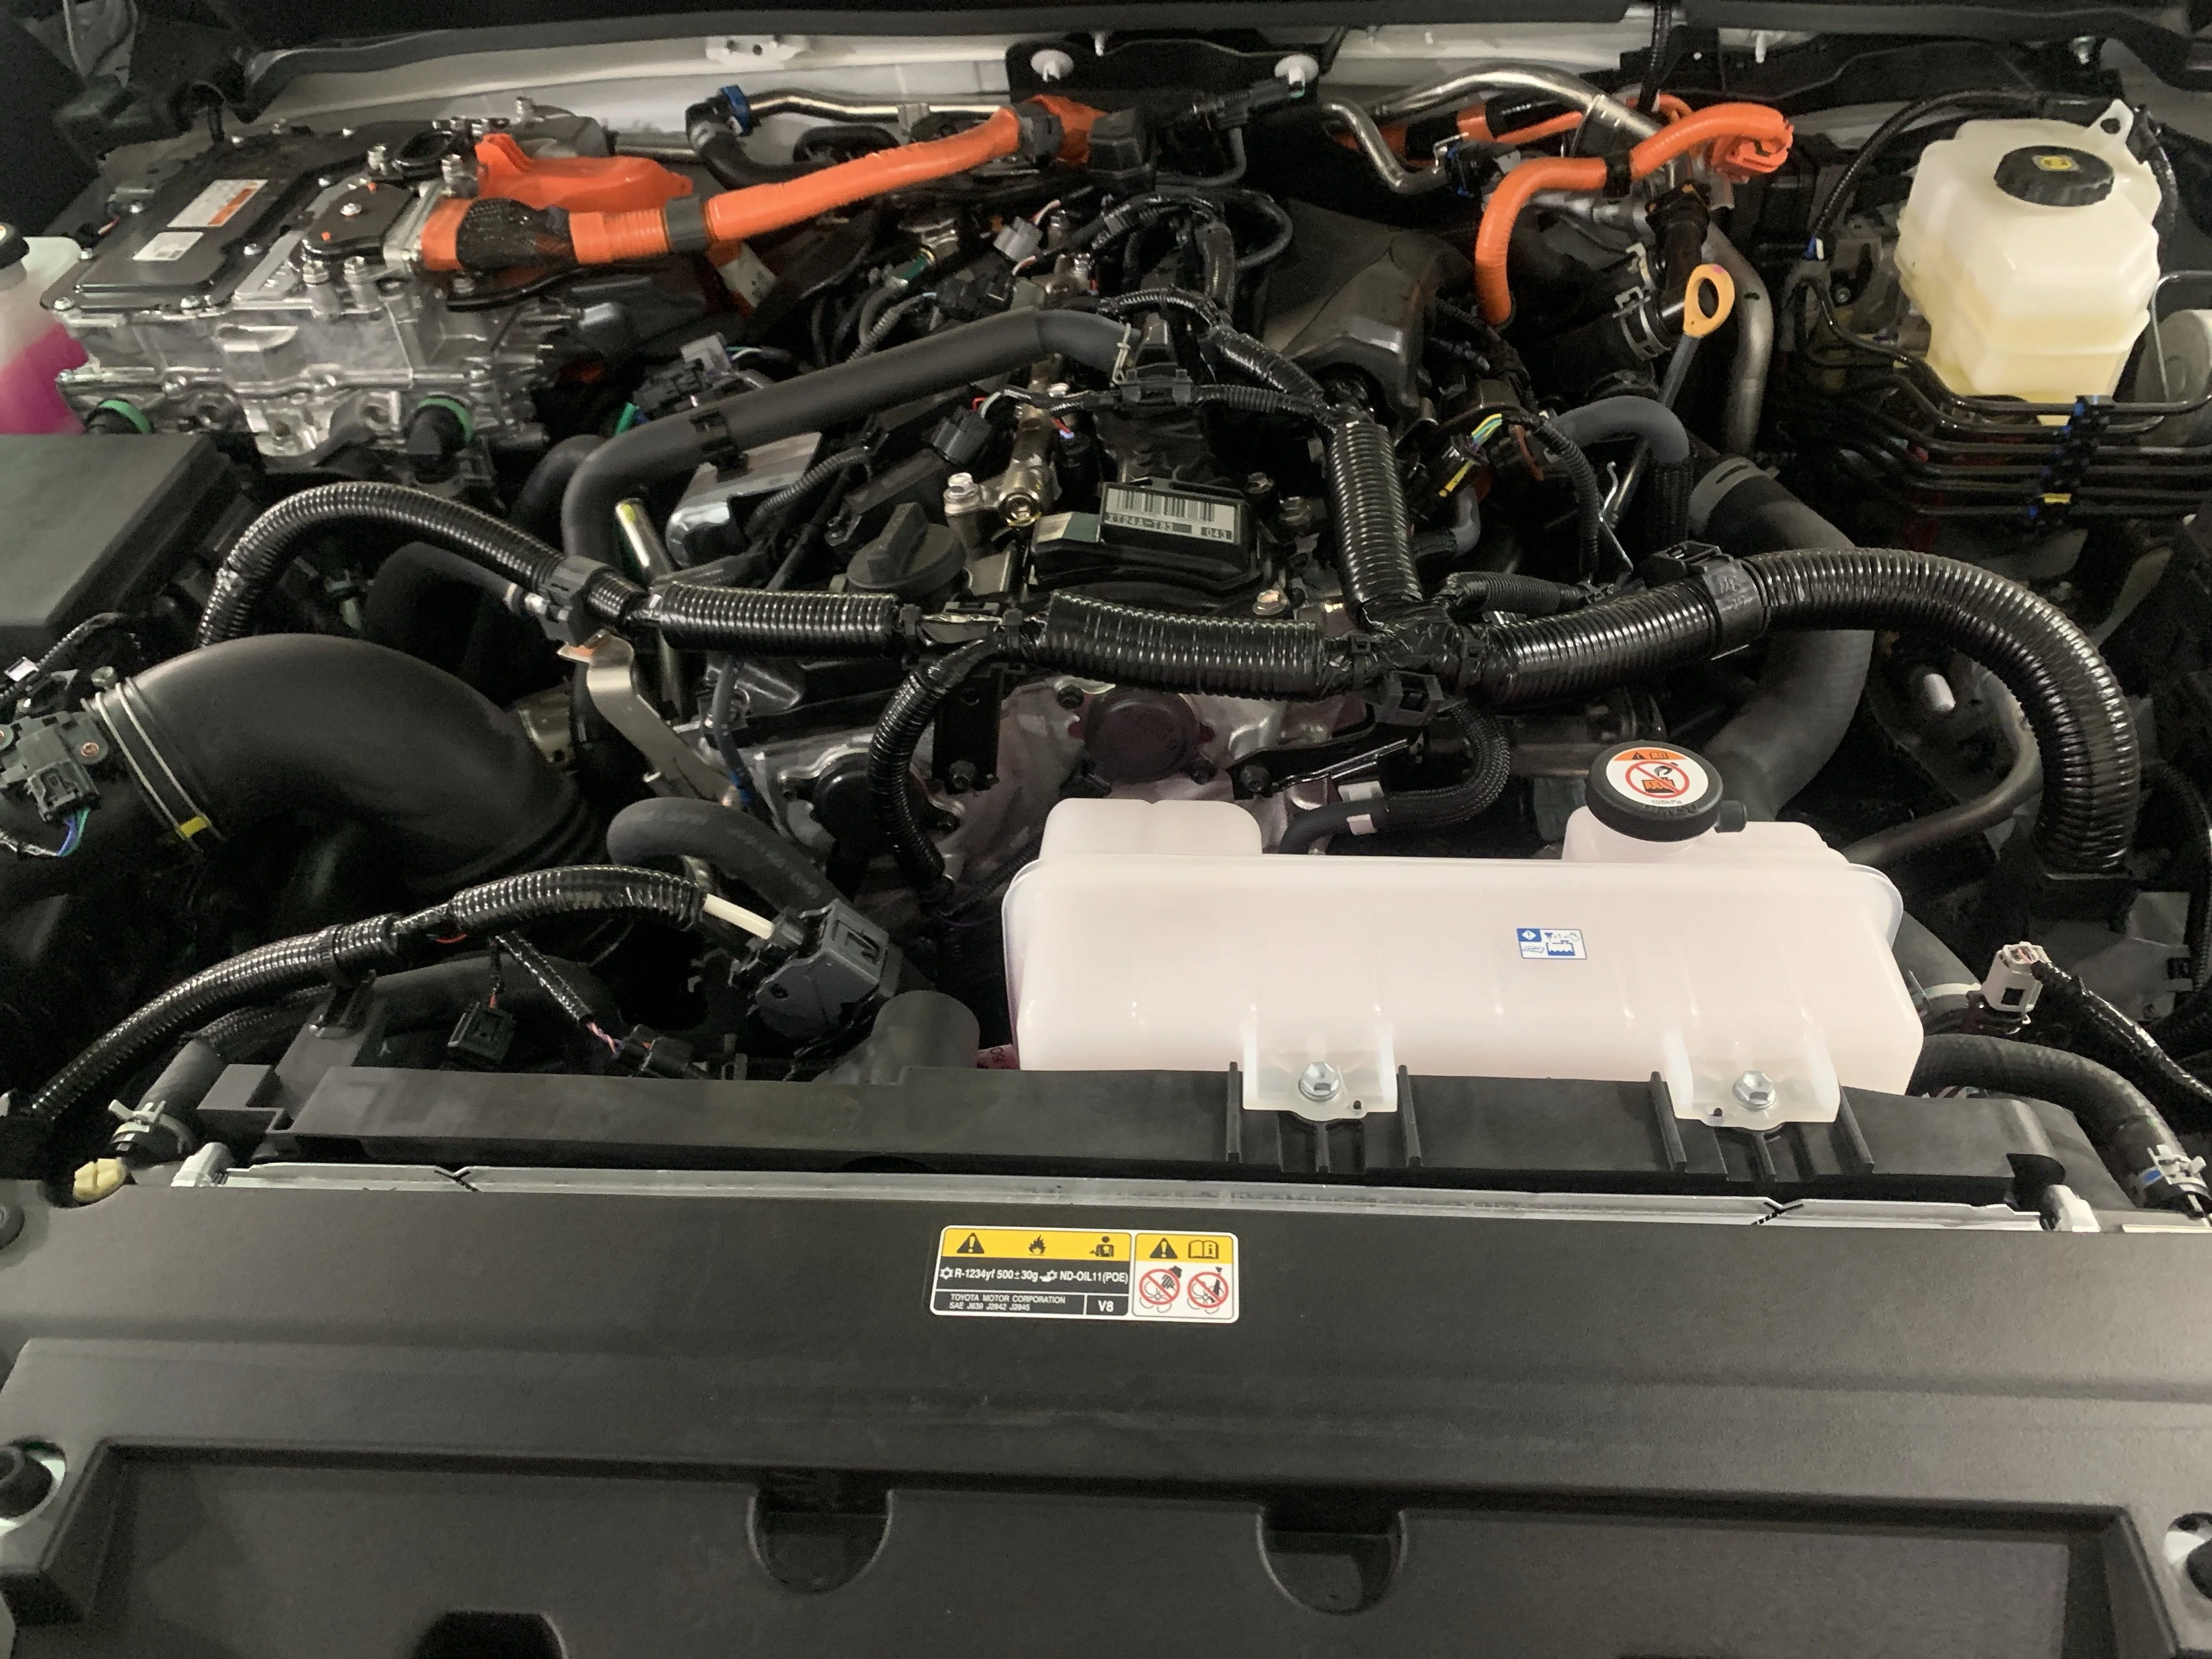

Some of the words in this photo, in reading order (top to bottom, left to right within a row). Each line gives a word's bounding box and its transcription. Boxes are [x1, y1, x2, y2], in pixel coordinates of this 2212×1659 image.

[951, 1293, 979, 1301] TOYOTA
[1012, 1295, 1066, 1304] CORPORATION
[1097, 1300, 1114, 1312] V8
